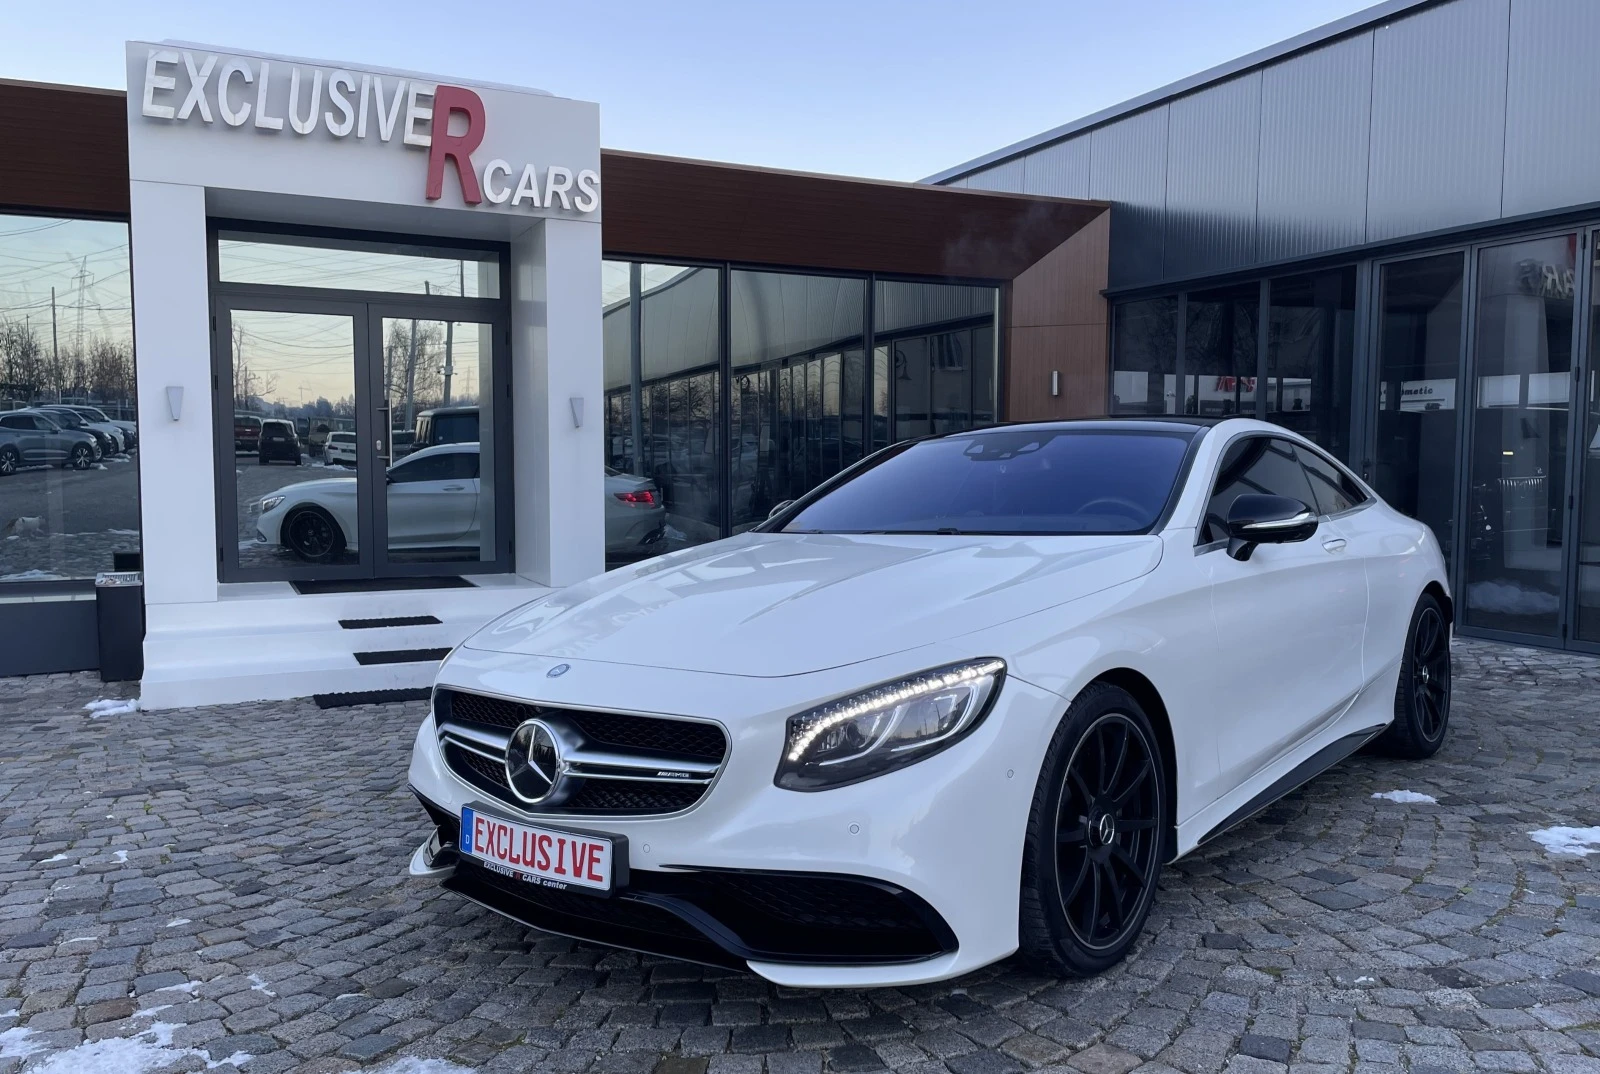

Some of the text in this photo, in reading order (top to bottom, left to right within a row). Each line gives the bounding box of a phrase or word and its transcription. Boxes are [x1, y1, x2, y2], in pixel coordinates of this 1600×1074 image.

[142, 49, 600, 213] EXCLUSIVE R CARS
[474, 816, 604, 882] EXCLUSIVE
[483, 860, 514, 877] EXCLUSIVE
[522, 874, 541, 885] CARS
[543, 880, 568, 890] center
